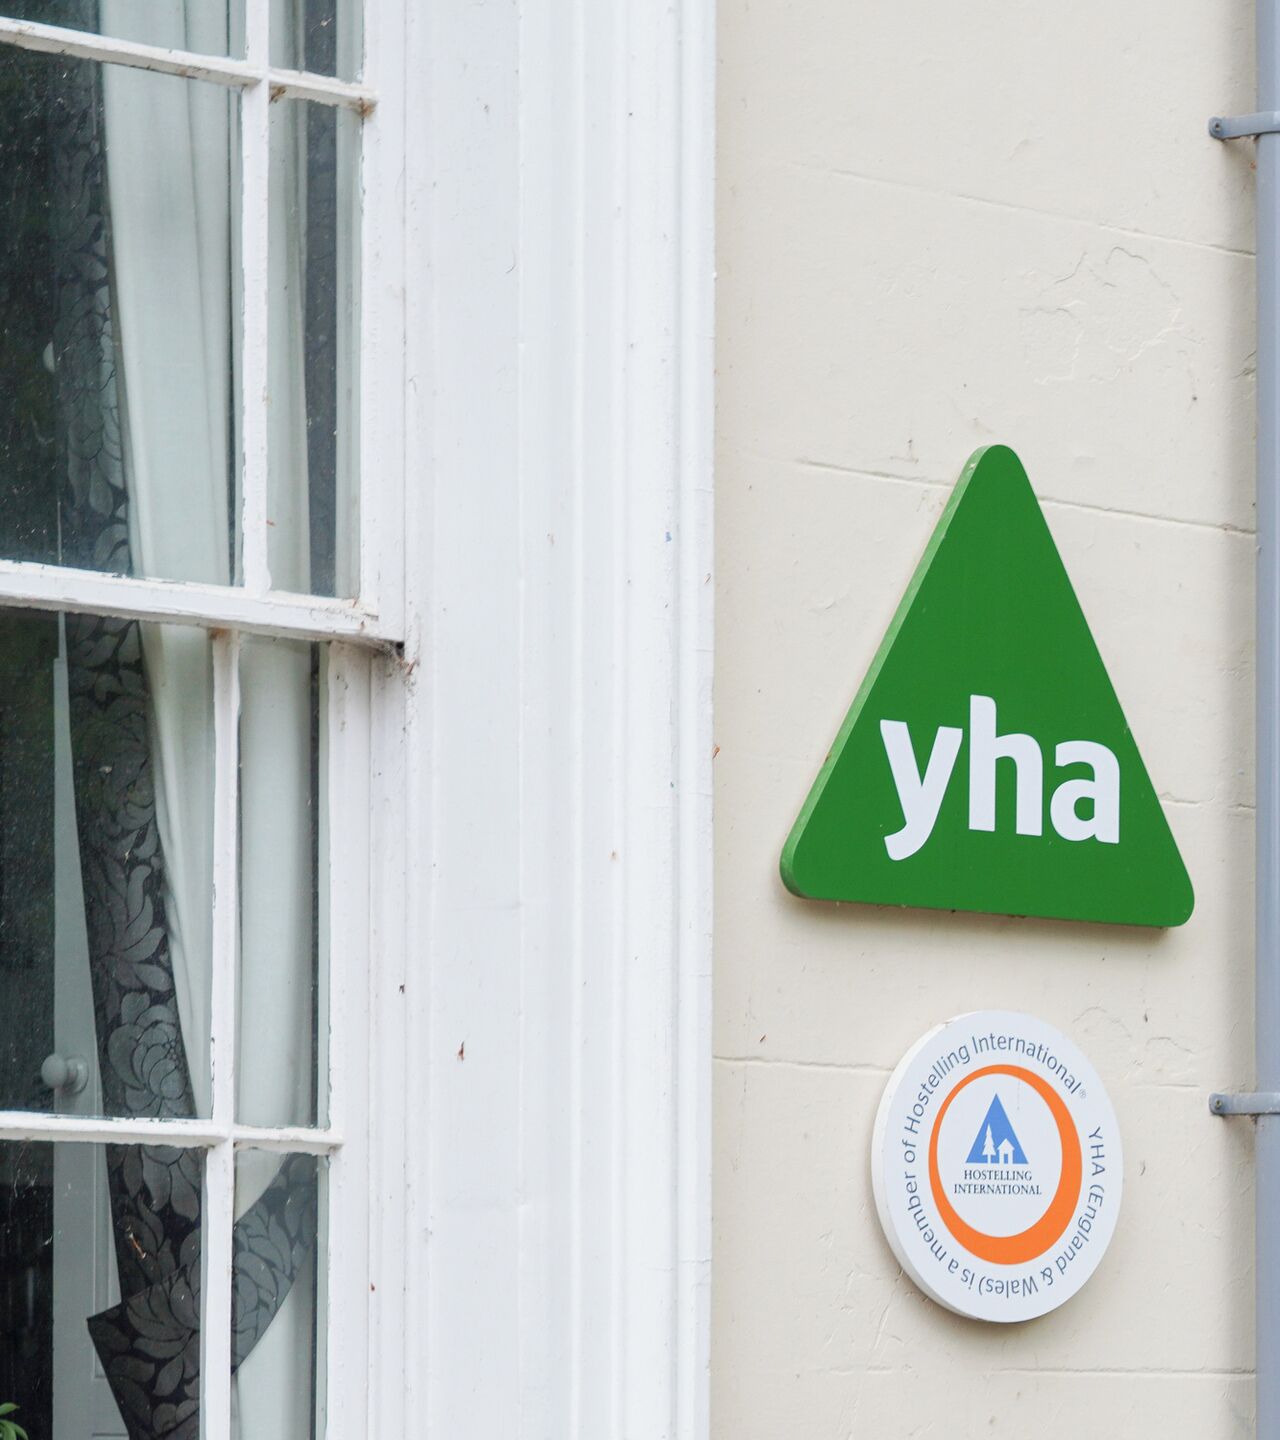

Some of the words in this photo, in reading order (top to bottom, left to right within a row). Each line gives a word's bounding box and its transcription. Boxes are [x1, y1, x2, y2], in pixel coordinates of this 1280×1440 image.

[880, 694, 1120, 861] yha
[904, 1045, 971, 1135] Hostelling
[901, 1139, 917, 1164] of
[1088, 1126, 1106, 1176] YHA
[964, 1169, 1033, 1181] HOSTELLING
[953, 1183, 1043, 1196] INTERNATIONAL
[904, 1171, 948, 1262] member
[1055, 1184, 1105, 1276] (England
[947, 1258, 959, 1274] a
[1040, 1266, 1054, 1286] &
[960, 1268, 976, 1290] is
[978, 1275, 1039, 1299] Wales)
